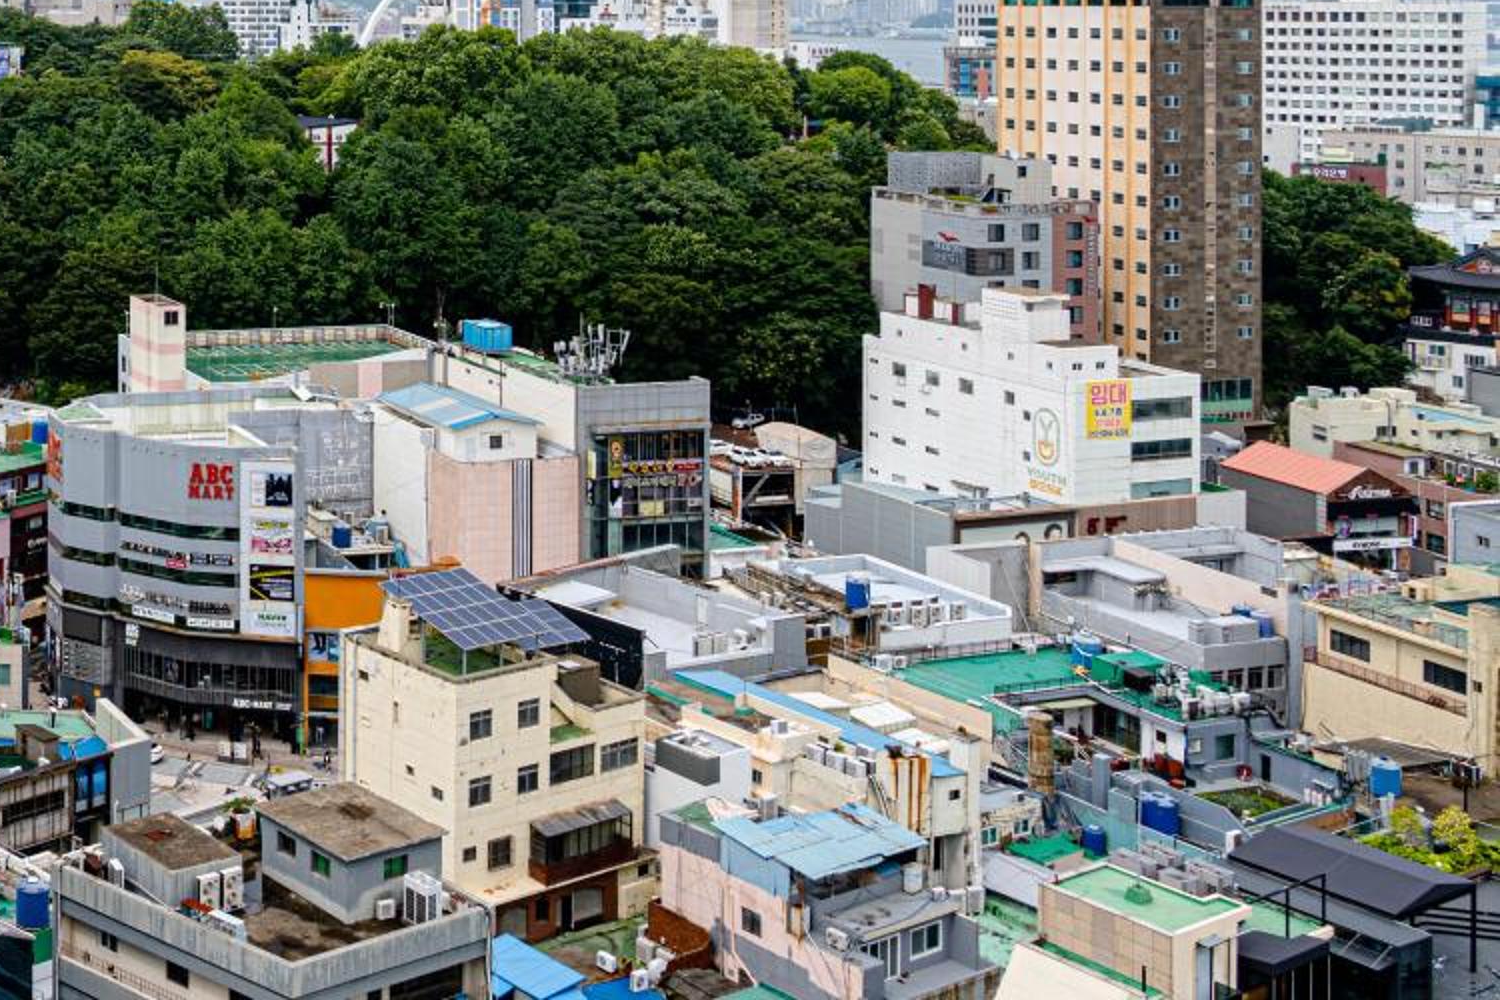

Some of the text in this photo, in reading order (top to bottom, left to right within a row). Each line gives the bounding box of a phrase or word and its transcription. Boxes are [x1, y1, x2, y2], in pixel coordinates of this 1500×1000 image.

[1091, 383, 1127, 405] 임대
[189, 462, 234, 485] ABC
[187, 484, 236, 500] MART
